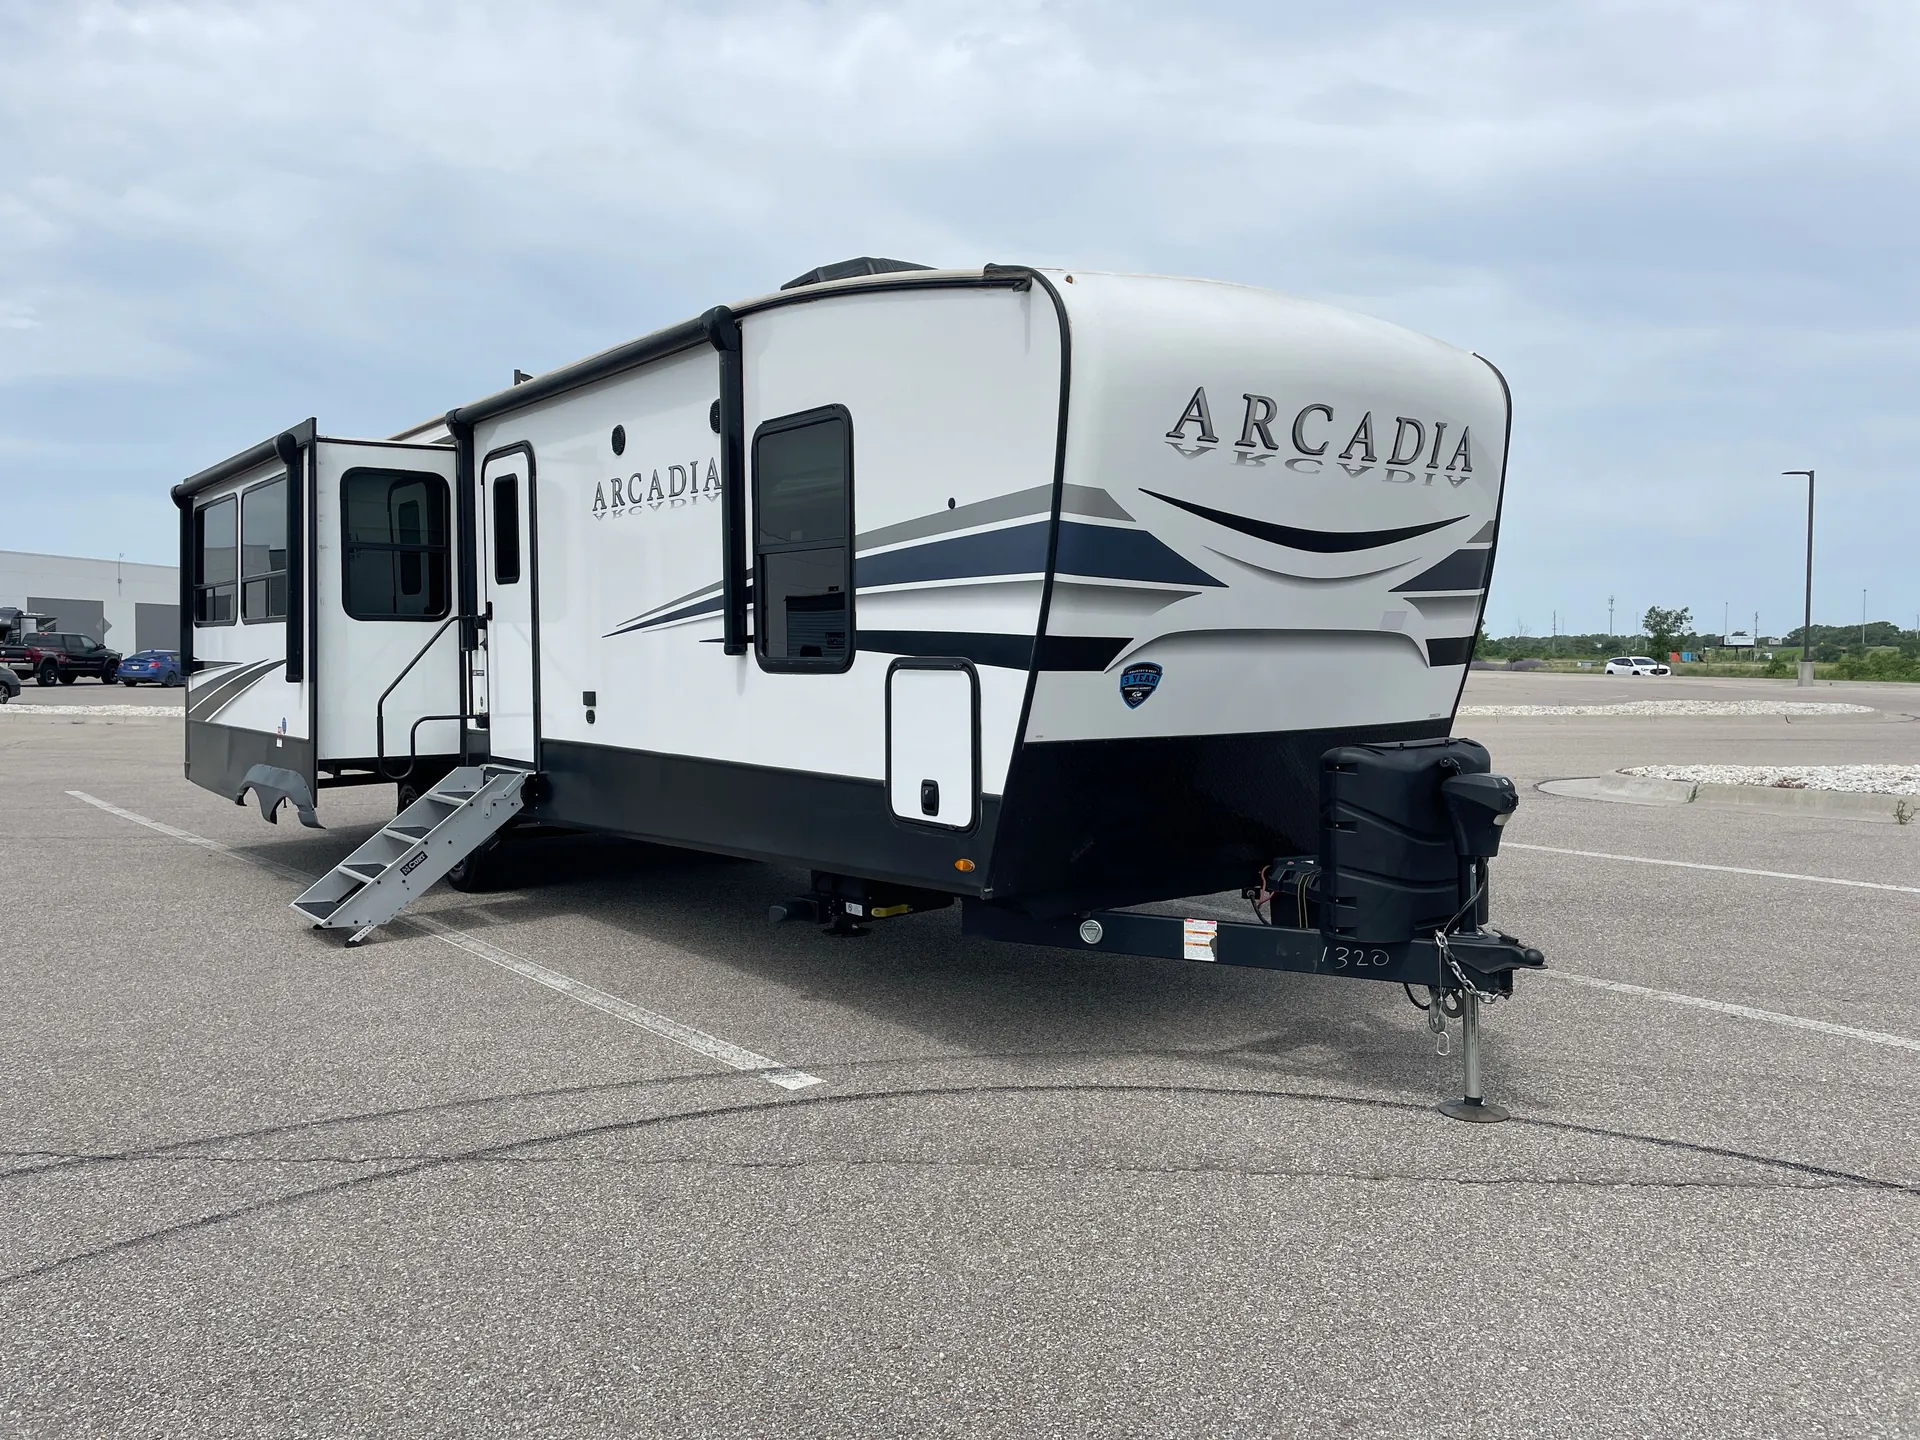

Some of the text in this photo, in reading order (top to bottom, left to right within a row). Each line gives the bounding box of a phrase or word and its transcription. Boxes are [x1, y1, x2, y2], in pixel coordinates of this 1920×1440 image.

[1165, 386, 1473, 473] ARCADIA
[592, 457, 723, 512] ARCADIA
[1124, 675, 1157, 685] 3 YEAR
[1320, 946, 1390, 969] 1320
